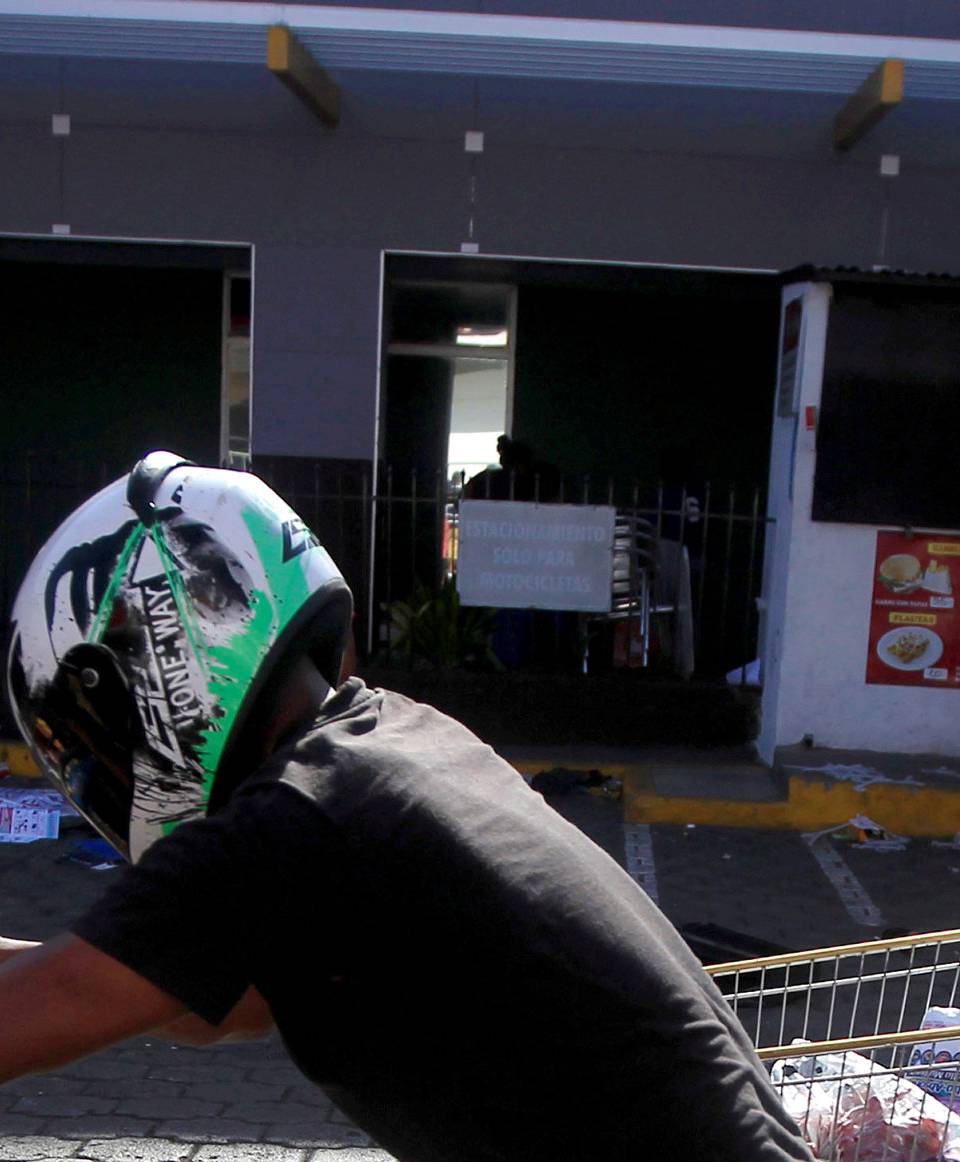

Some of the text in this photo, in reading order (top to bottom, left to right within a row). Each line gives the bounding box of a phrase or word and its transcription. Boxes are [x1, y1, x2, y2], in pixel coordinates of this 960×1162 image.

[537, 549, 575, 567] PARA
[144, 586, 195, 707] ONE WAY
